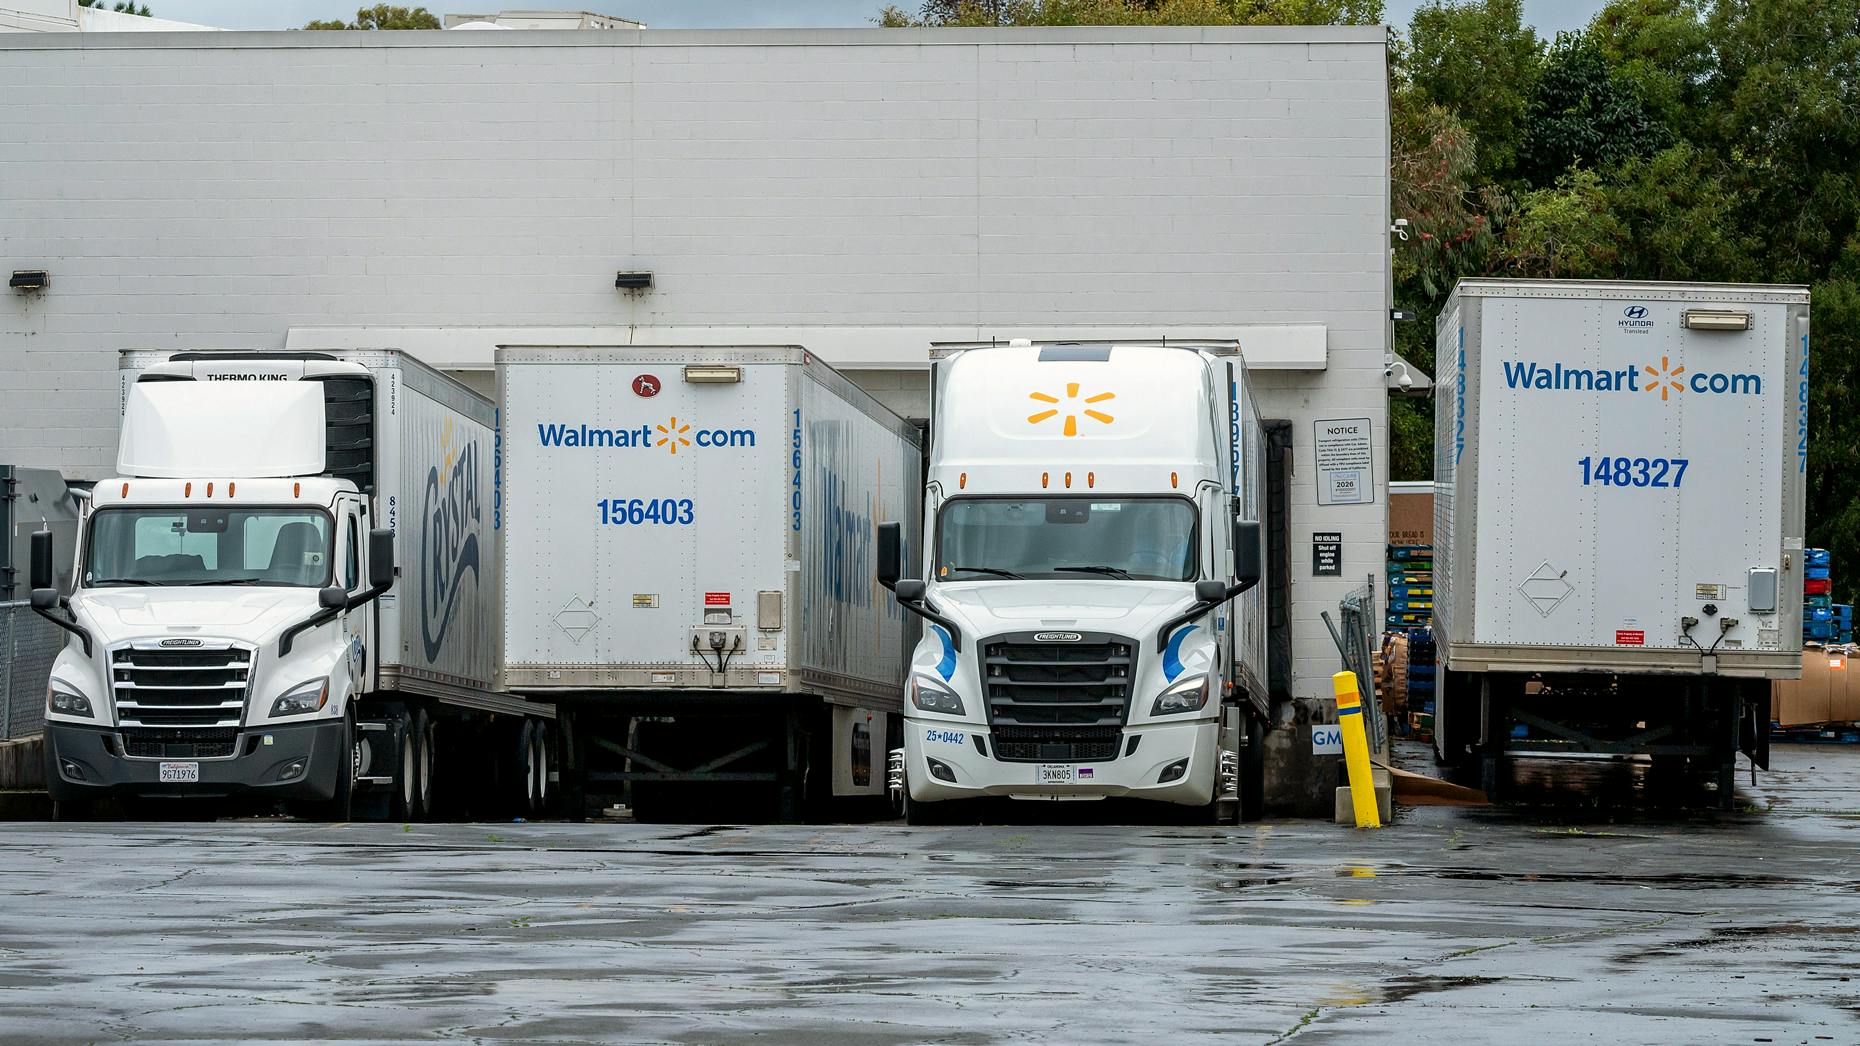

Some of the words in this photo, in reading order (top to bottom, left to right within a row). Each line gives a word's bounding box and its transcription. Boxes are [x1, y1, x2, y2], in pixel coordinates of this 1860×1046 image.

[1504, 362, 1638, 391] Walmart
[1690, 372, 1761, 394] com
[1456, 327, 1466, 464] 148327
[1798, 335, 1809, 473] 148327
[538, 423, 651, 447] Walmart
[696, 429, 755, 447] com
[1327, 426, 1358, 434] NOTICE
[793, 408, 801, 531] 156403
[1578, 457, 1689, 487] 148327
[597, 498, 694, 525] 156403
[421, 439, 480, 664] CRYSTAL
[1313, 731, 1341, 745] GM
[1042, 769, 1071, 780] 3KN805
